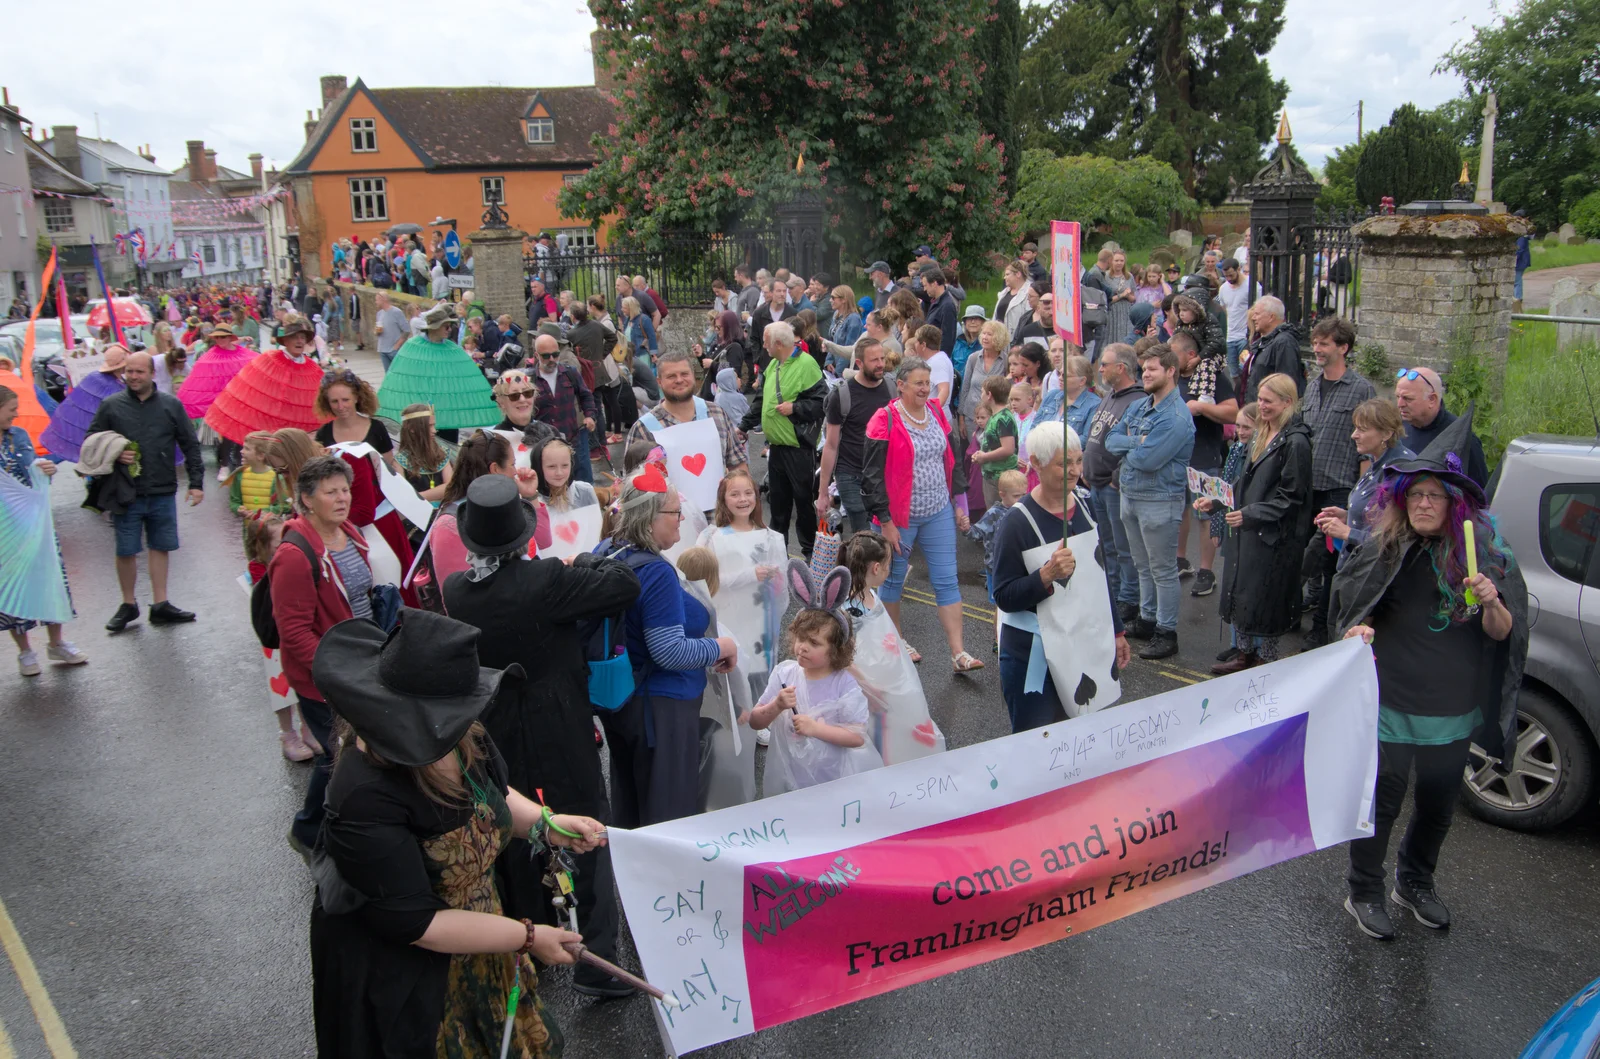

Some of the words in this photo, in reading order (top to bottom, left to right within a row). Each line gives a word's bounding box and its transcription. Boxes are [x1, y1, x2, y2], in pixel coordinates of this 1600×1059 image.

[1247, 673, 1272, 694] AT
[1234, 692, 1280, 714] CASTLE
[1248, 707, 1280, 727] PUB
[1102, 709, 1181, 750] TUESDAYS
[1114, 749, 1127, 761] OF
[1136, 736, 1168, 753] MONTH
[1063, 767, 1082, 780] AND
[932, 857, 1033, 907] come
[1039, 824, 1111, 874] and
[1116, 806, 1179, 861] join
[653, 879, 705, 923] SAY
[743, 855, 862, 944] WELCOME
[749, 865, 806, 912] ALL
[845, 884, 1097, 976] Framlingham
[1104, 830, 1231, 901] Friends!
[676, 927, 702, 947] OR
